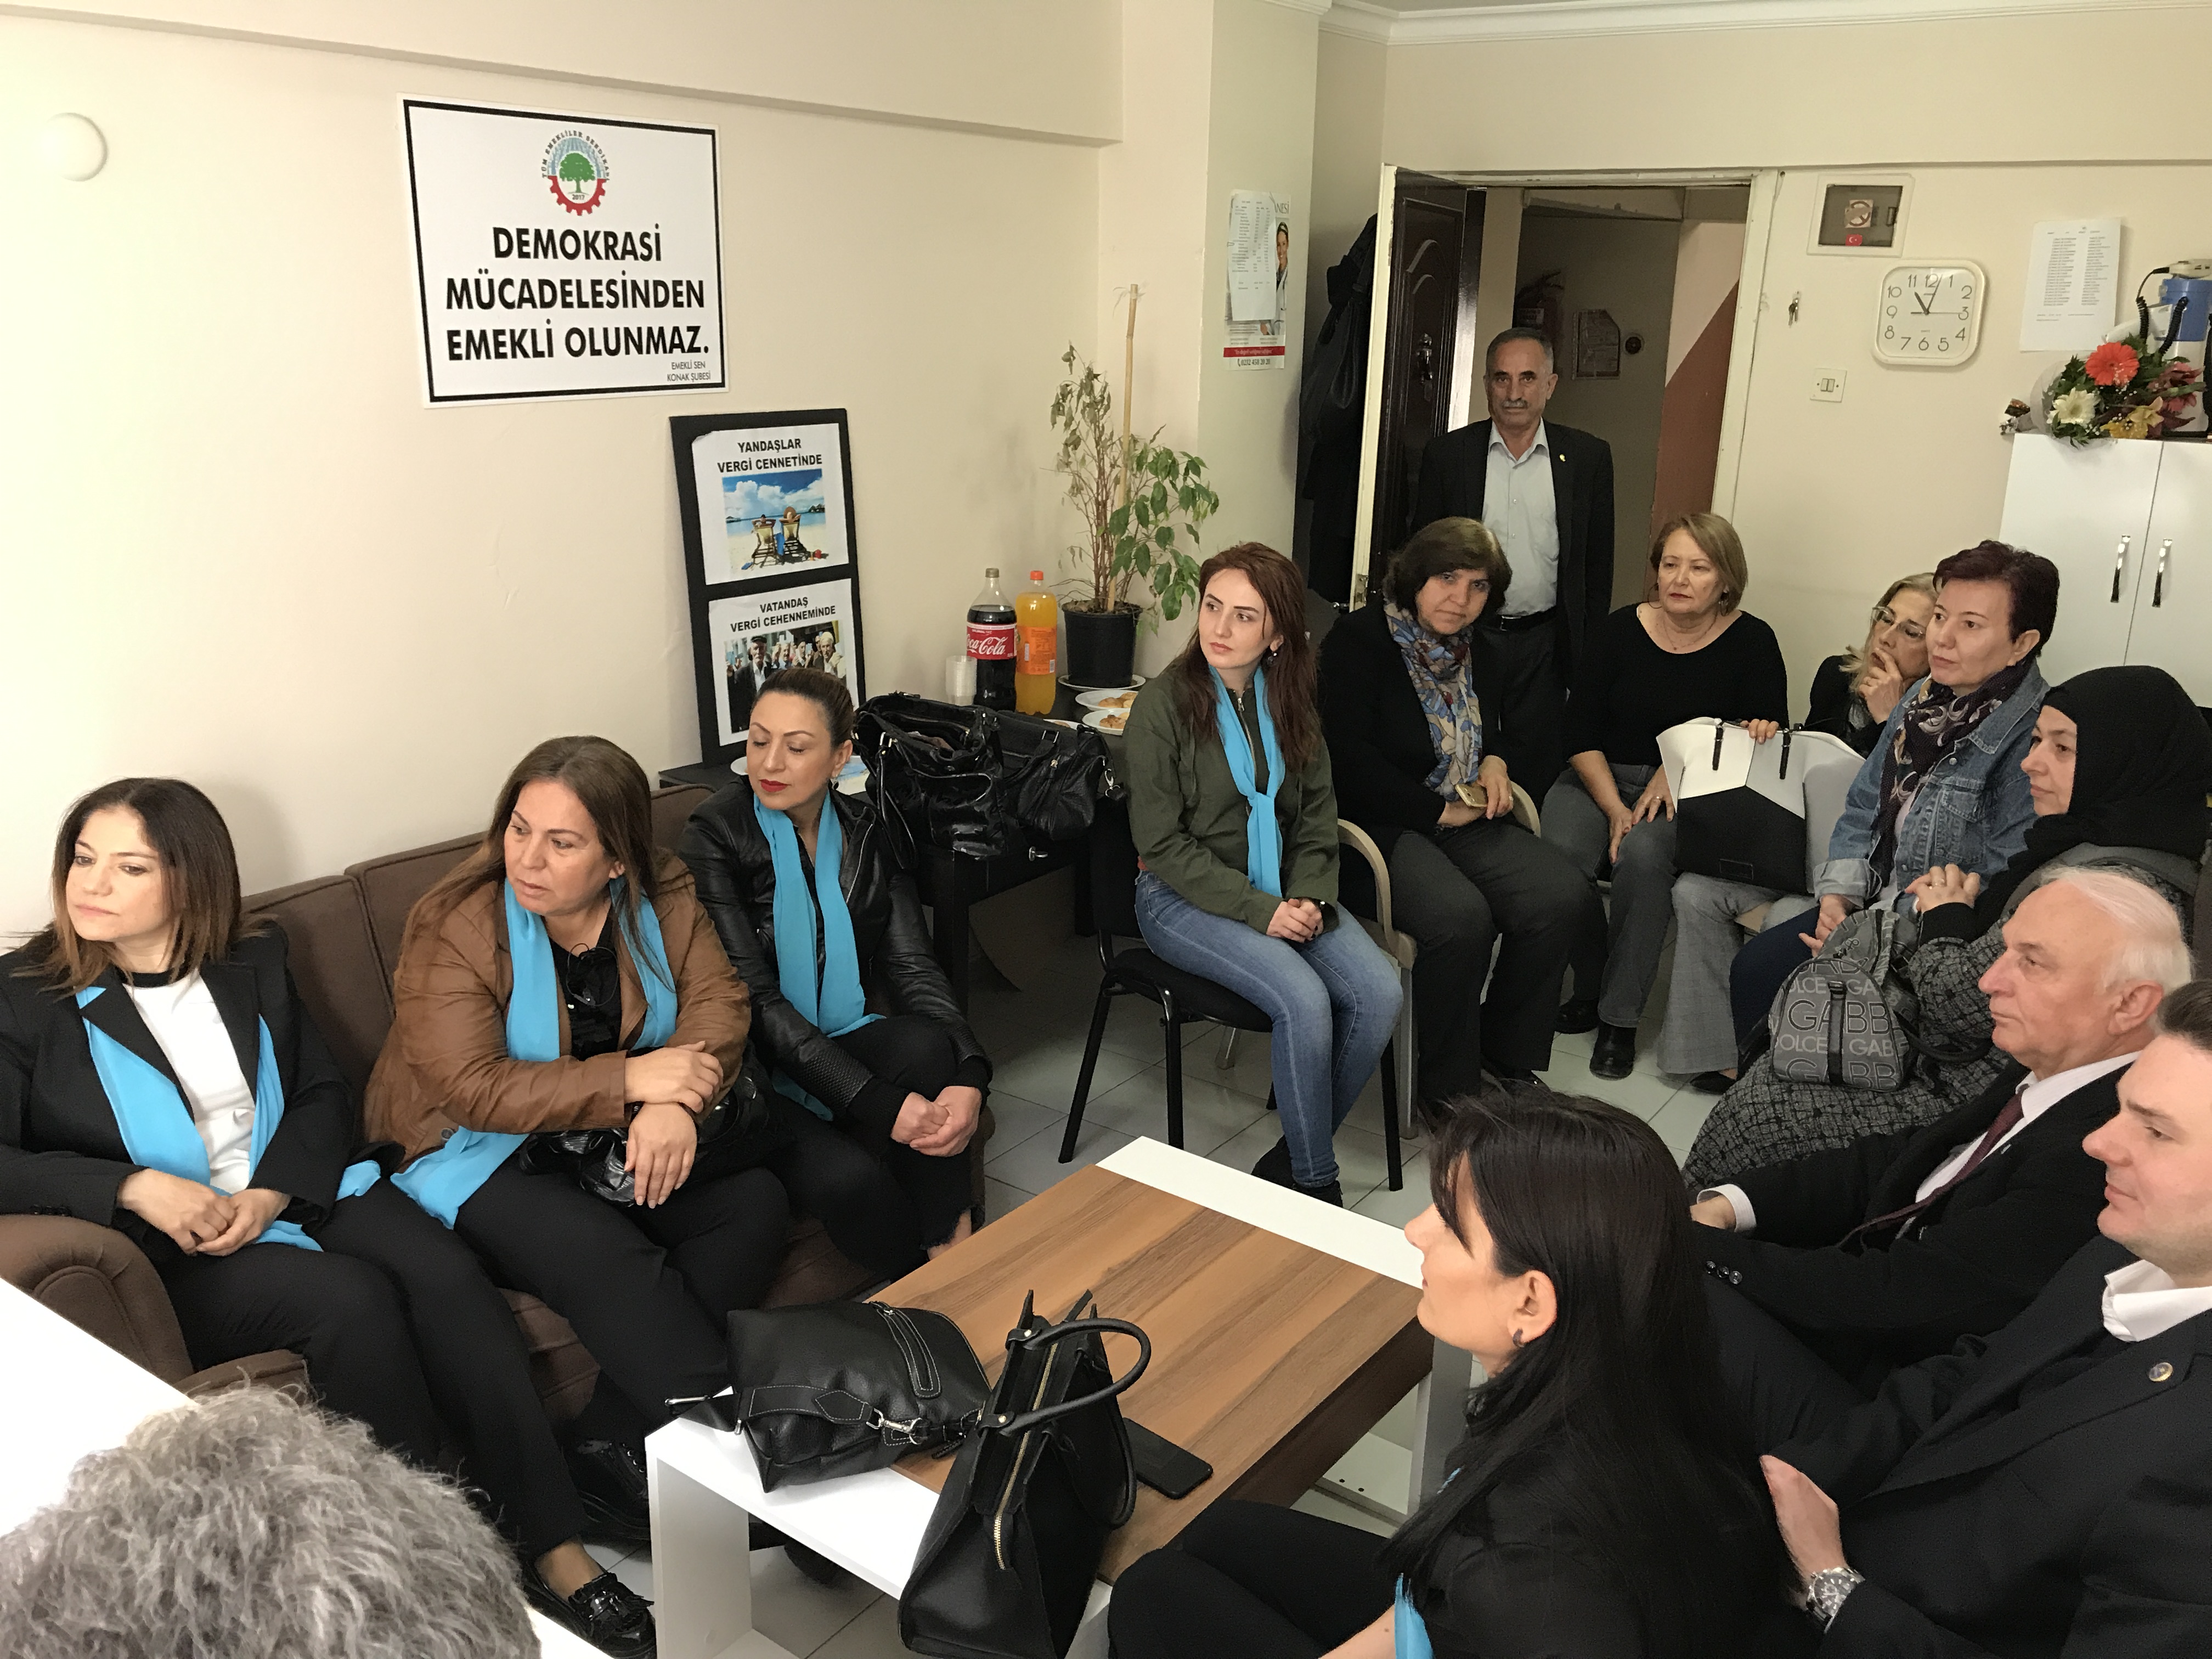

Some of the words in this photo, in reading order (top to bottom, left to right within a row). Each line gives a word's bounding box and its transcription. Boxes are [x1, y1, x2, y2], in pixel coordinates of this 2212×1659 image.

[493, 223, 662, 262] DEMOKRASİ
[1908, 274, 1917, 288] 11
[1925, 274, 1938, 288] 12
[1949, 274, 1954, 288] 1
[446, 268, 704, 310] MÜCADELESİNDEN
[1887, 285, 1902, 298] 10
[1961, 285, 1972, 300] 2
[1886, 305, 1898, 319] 9
[1958, 306, 1969, 320] 3
[447, 318, 554, 361] EMEKLİ
[565, 325, 709, 358] OLUNMAZ.
[1884, 325, 1894, 340] 8
[1955, 327, 1966, 341] 4
[1900, 336, 1912, 351] 7
[1918, 337, 1929, 351] 6
[1938, 337, 1949, 352] 5
[671, 359, 692, 370] EMEKLİ
[694, 361, 706, 369] SEN
[667, 373, 690, 382] KONAK
[691, 370, 711, 382] ŞUBESİ
[737, 438, 802, 453] YANDAŞLAR
[717, 458, 752, 473] VERGİ
[755, 453, 822, 470] CENNETİNDE
[760, 596, 809, 613] VATANDAŞ
[730, 617, 761, 633] VERGİ
[763, 605, 836, 627] CEHENNEMİNDE
[1775, 1034, 1828, 1053] OLCE
